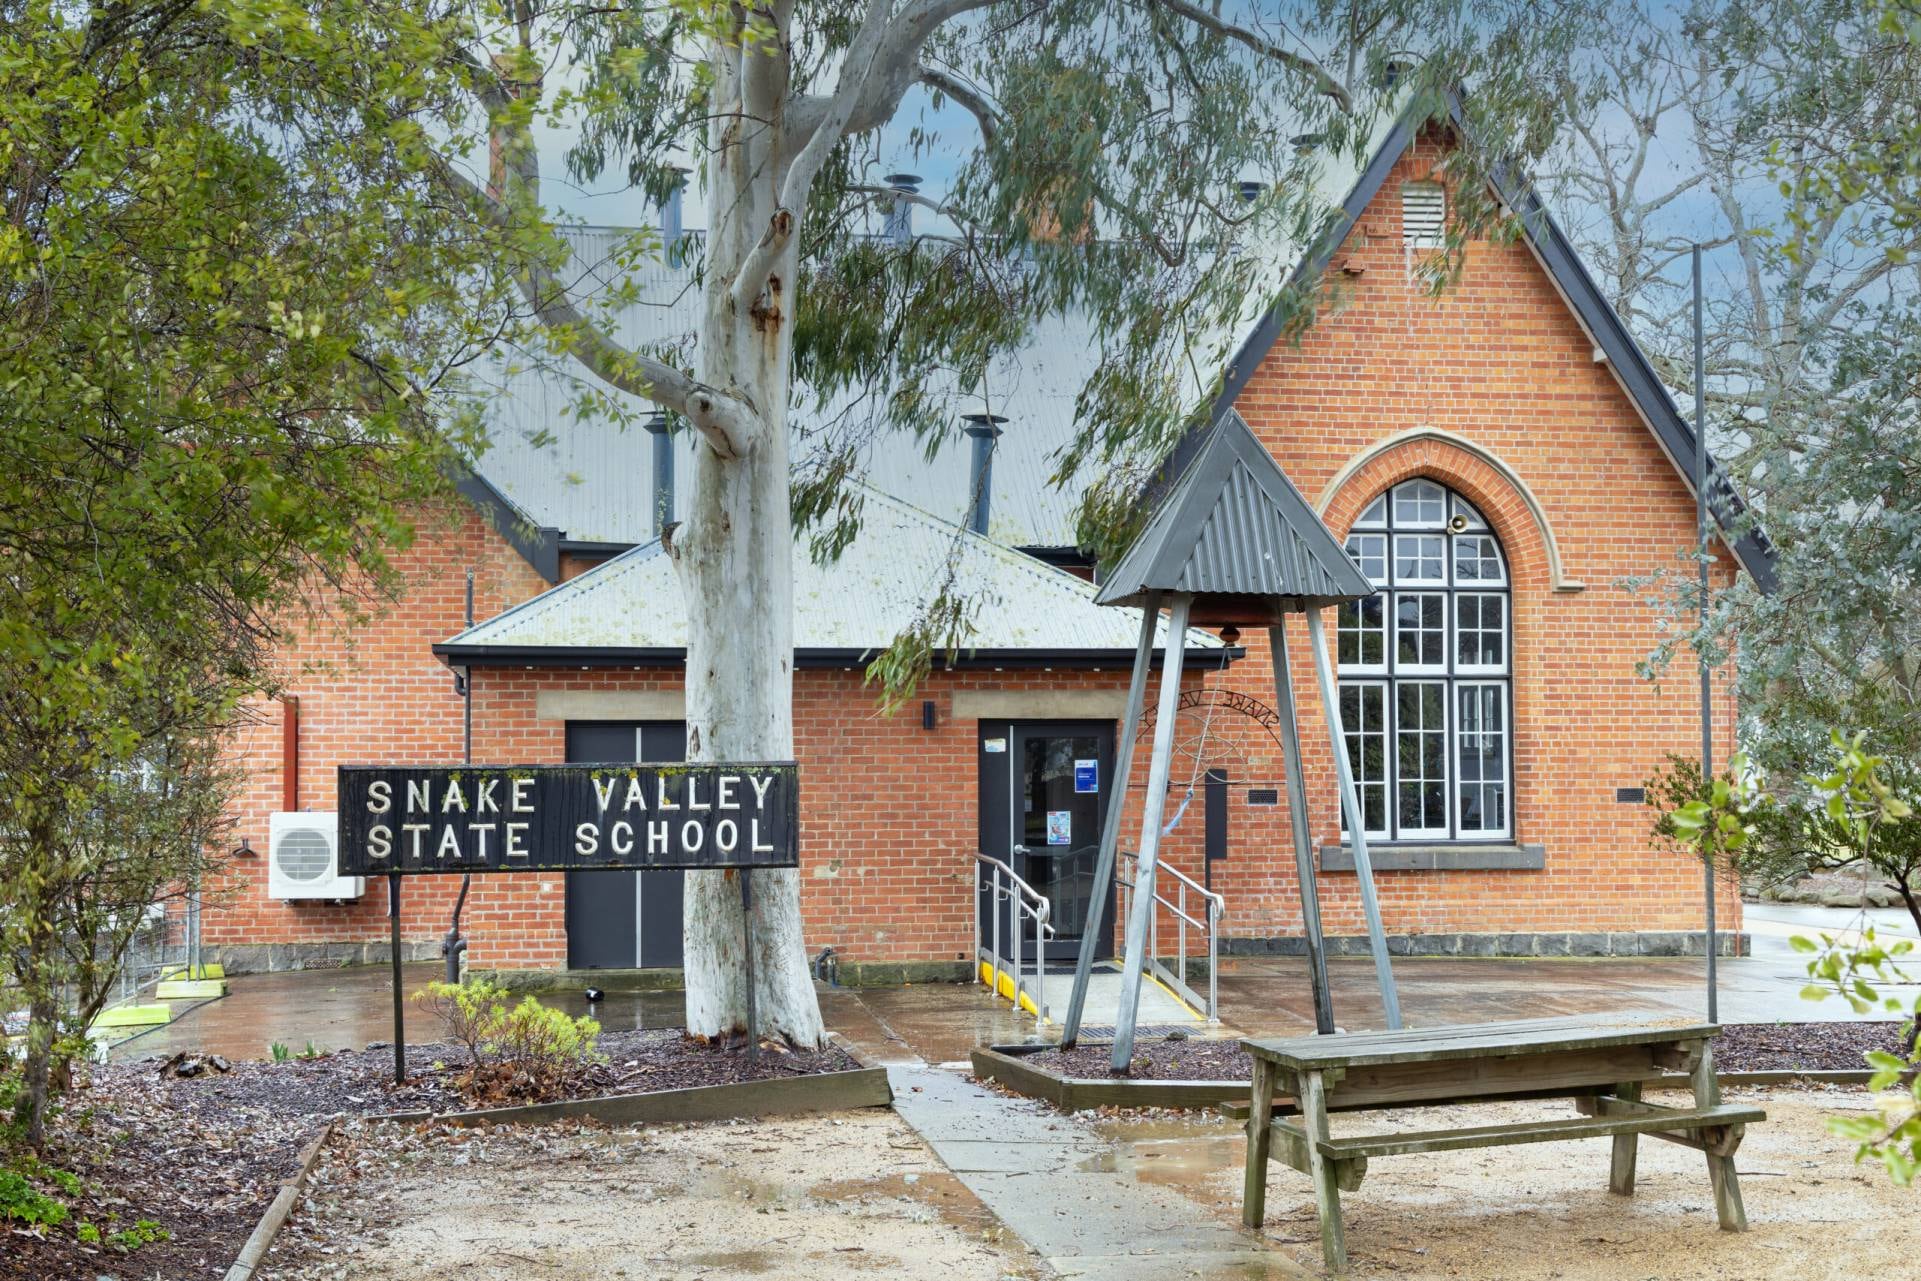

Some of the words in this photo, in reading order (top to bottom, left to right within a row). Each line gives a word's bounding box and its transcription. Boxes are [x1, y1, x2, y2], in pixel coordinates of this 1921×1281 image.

[366, 778, 536, 815] SNAKE
[592, 776, 774, 812] VALLEY
[366, 822, 529, 859] STATE
[574, 818, 774, 857] SCHOOL
